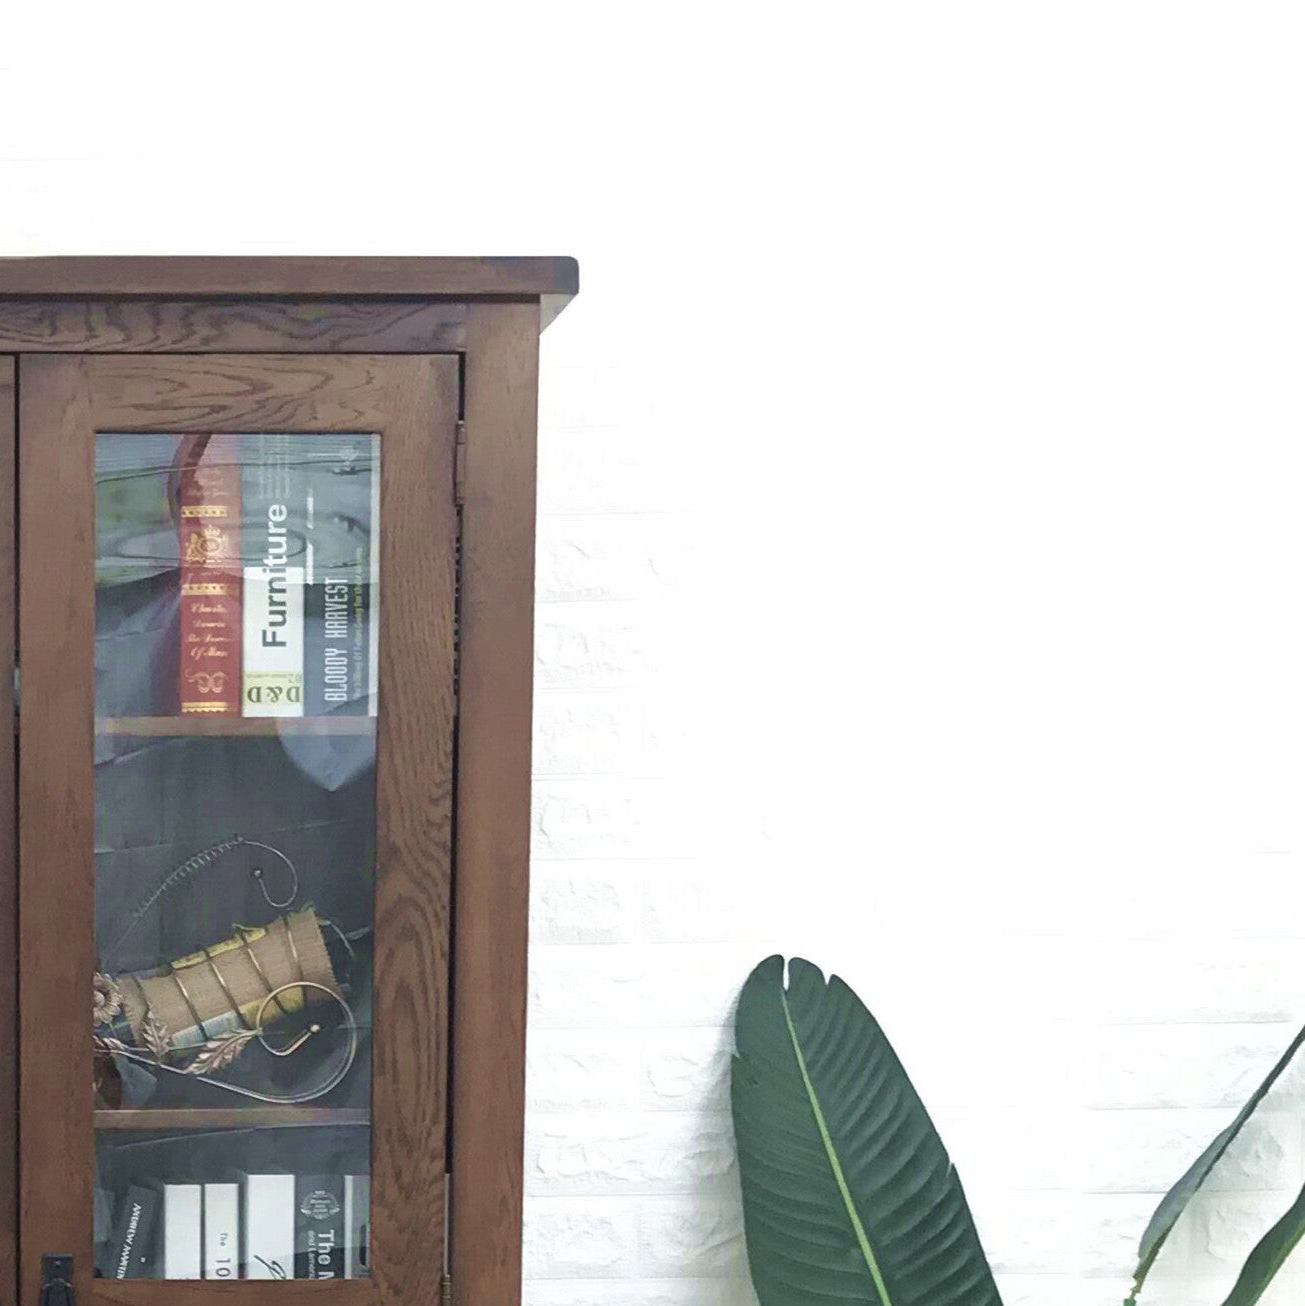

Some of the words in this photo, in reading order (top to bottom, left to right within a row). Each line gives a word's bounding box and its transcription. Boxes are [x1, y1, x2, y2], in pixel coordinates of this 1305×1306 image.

[262, 503, 288, 648] Furniture
[323, 575, 348, 640] HARVEST
[323, 647, 348, 703] BLOODY
[317, 1229, 335, 1265] The
